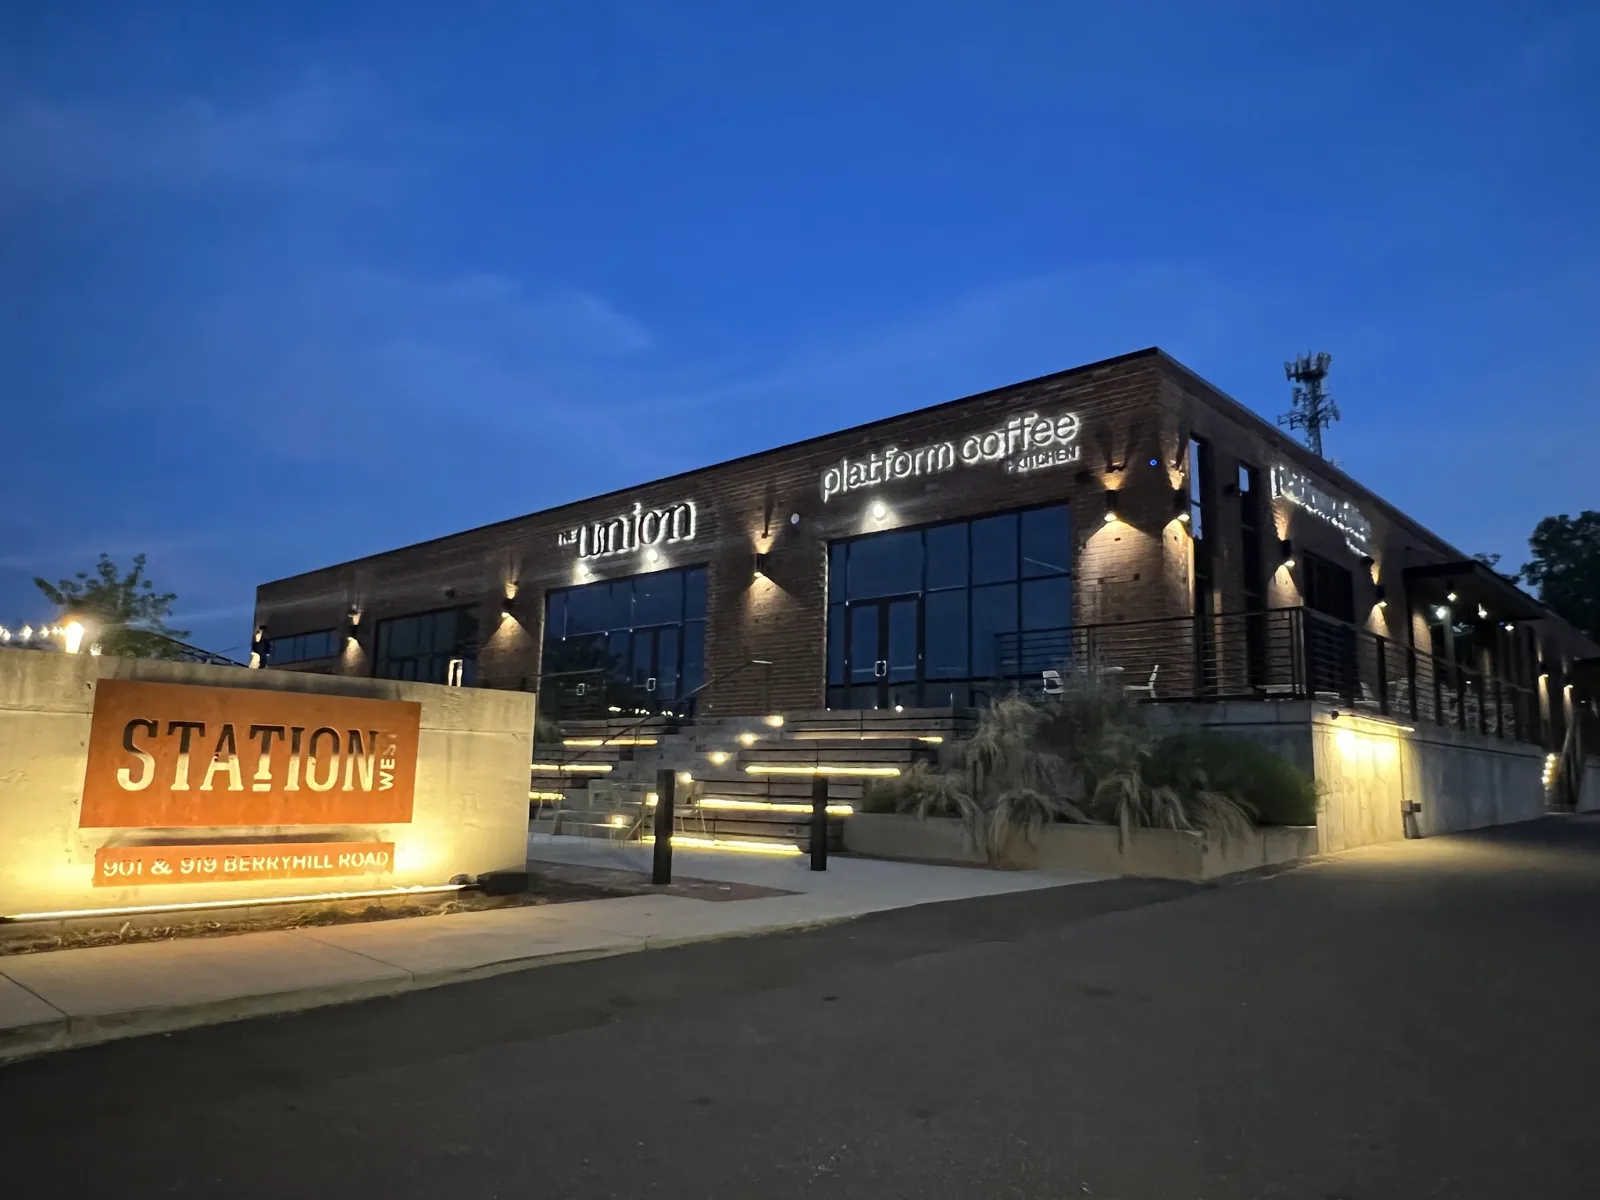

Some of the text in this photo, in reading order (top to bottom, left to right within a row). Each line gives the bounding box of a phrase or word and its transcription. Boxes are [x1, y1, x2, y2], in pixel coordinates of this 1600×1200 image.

[822, 412, 1081, 503] platform coffee
[578, 502, 697, 560] union
[116, 718, 380, 793] STATION
[378, 730, 398, 792] WEST
[103, 850, 389, 877] 901 & 919 BERRYHILL ROAD
